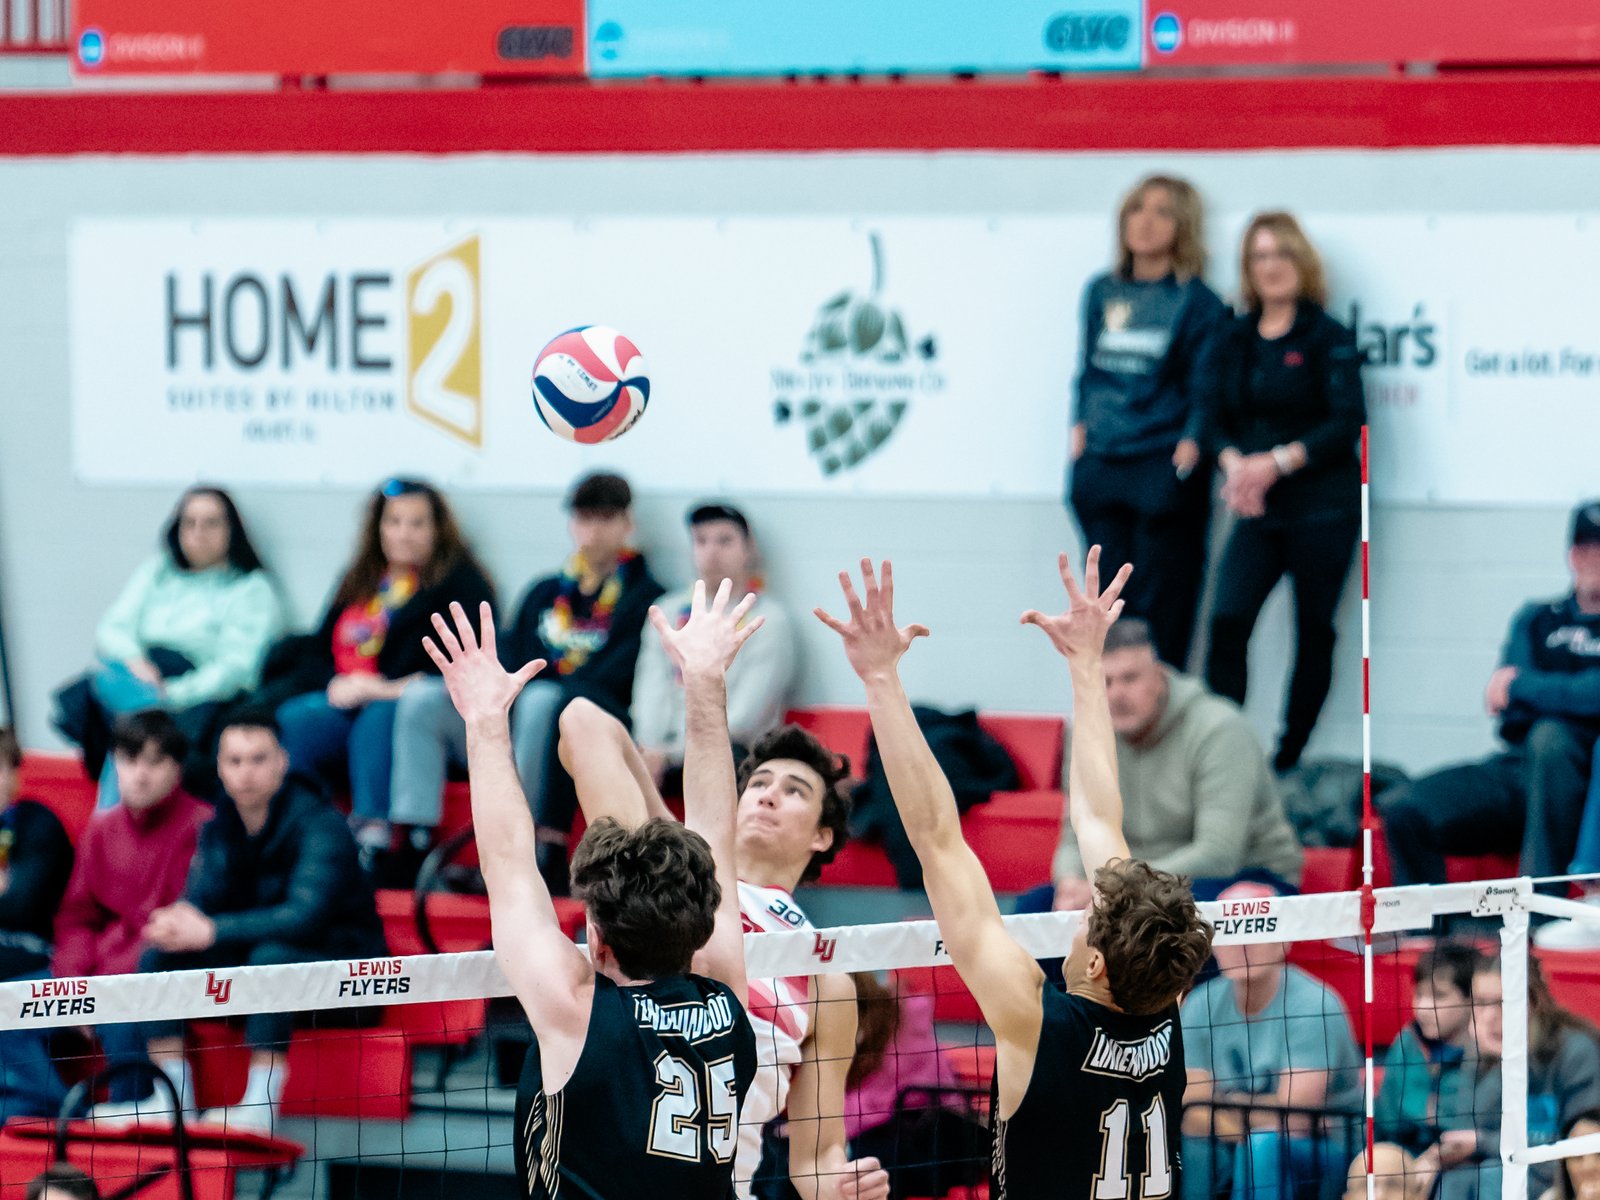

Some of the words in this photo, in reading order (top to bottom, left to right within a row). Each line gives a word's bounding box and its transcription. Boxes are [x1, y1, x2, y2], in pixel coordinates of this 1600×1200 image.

[164, 272, 392, 370] HOME
[409, 256, 476, 432] 2
[166, 388, 254, 411] SUITES
[265, 388, 297, 410] BY
[307, 388, 395, 411] HILTON
[768, 899, 805, 926] 30
[1222, 901, 1271, 917] LEWIS
[1213, 917, 1278, 935] FLYERS
[348, 959, 402, 977] LEWIS
[31, 979, 88, 998] LEWIS
[338, 976, 411, 998] FLYERS
[20, 996, 96, 1018] FLYERS
[646, 1050, 738, 1164] 25
